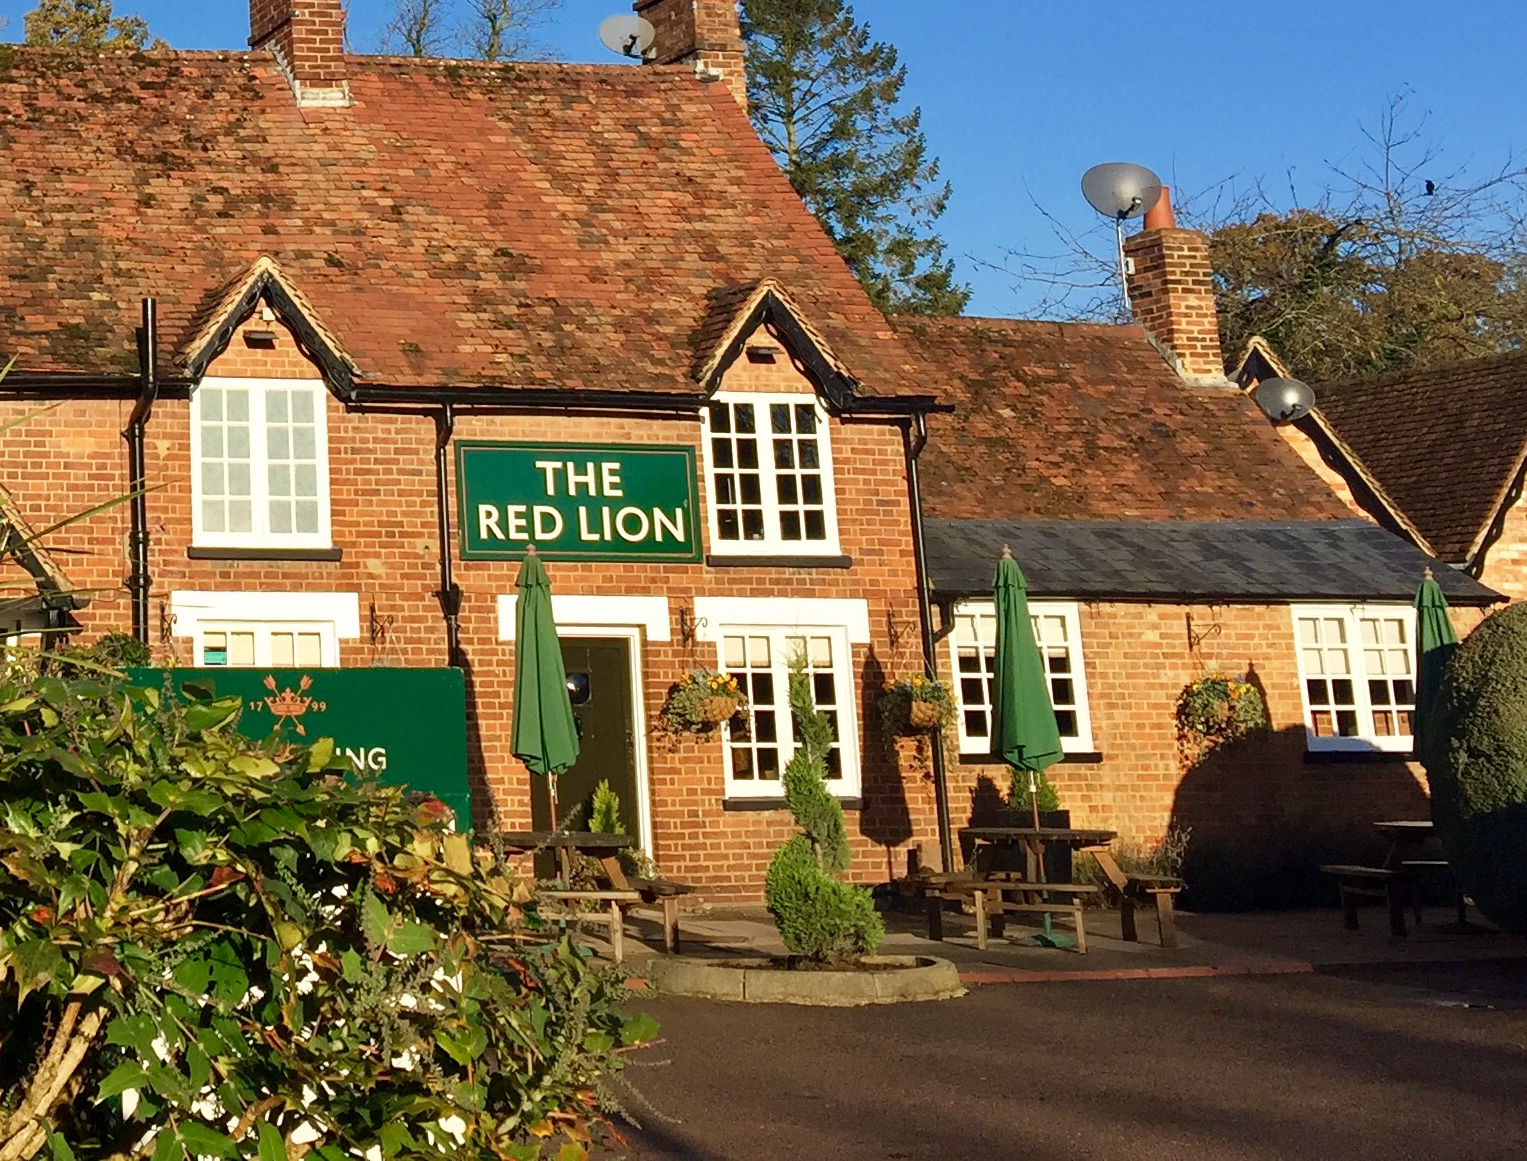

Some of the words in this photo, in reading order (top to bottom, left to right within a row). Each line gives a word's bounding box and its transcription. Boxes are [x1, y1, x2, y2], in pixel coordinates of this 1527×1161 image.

[535, 460, 623, 497] THE
[478, 504, 563, 541] RED
[578, 505, 686, 543] LION
